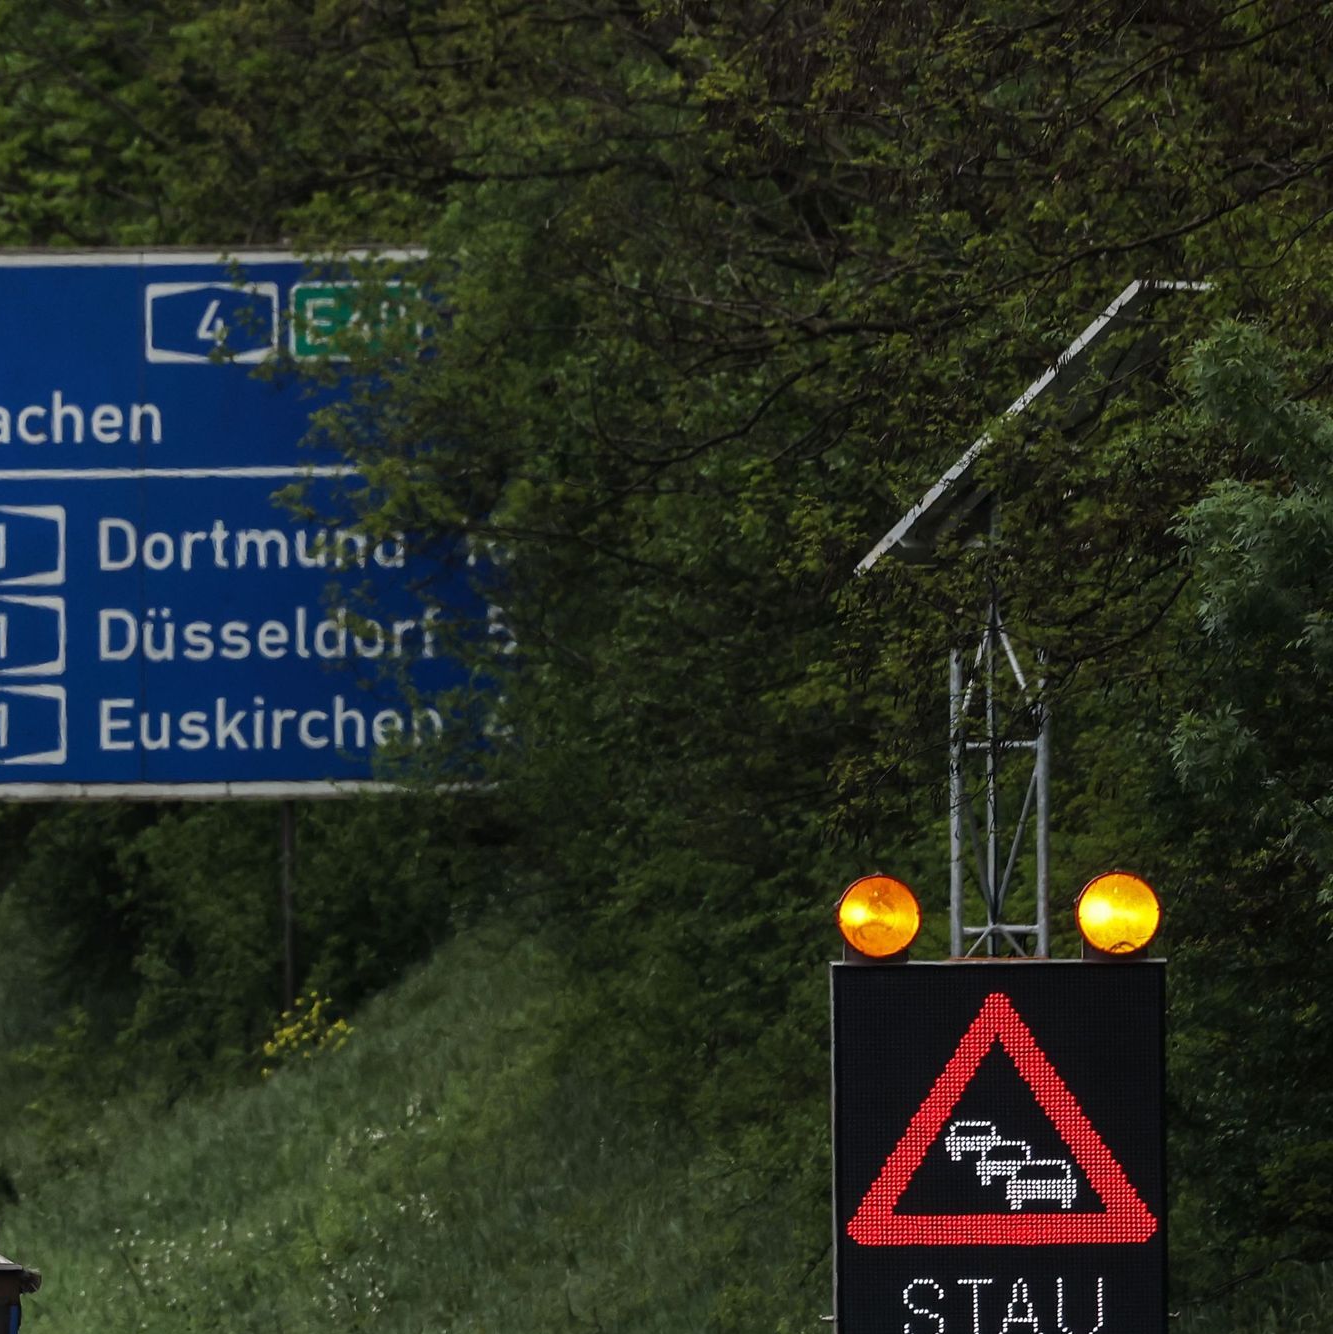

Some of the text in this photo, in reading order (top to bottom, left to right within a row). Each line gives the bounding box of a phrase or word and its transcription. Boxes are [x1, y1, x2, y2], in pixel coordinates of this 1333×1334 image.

[197, 299, 226, 346] 4
[98, 517, 405, 572] Dortmund
[98, 607, 442, 662] Düsseldorf
[98, 696, 444, 751] Euskirchen
